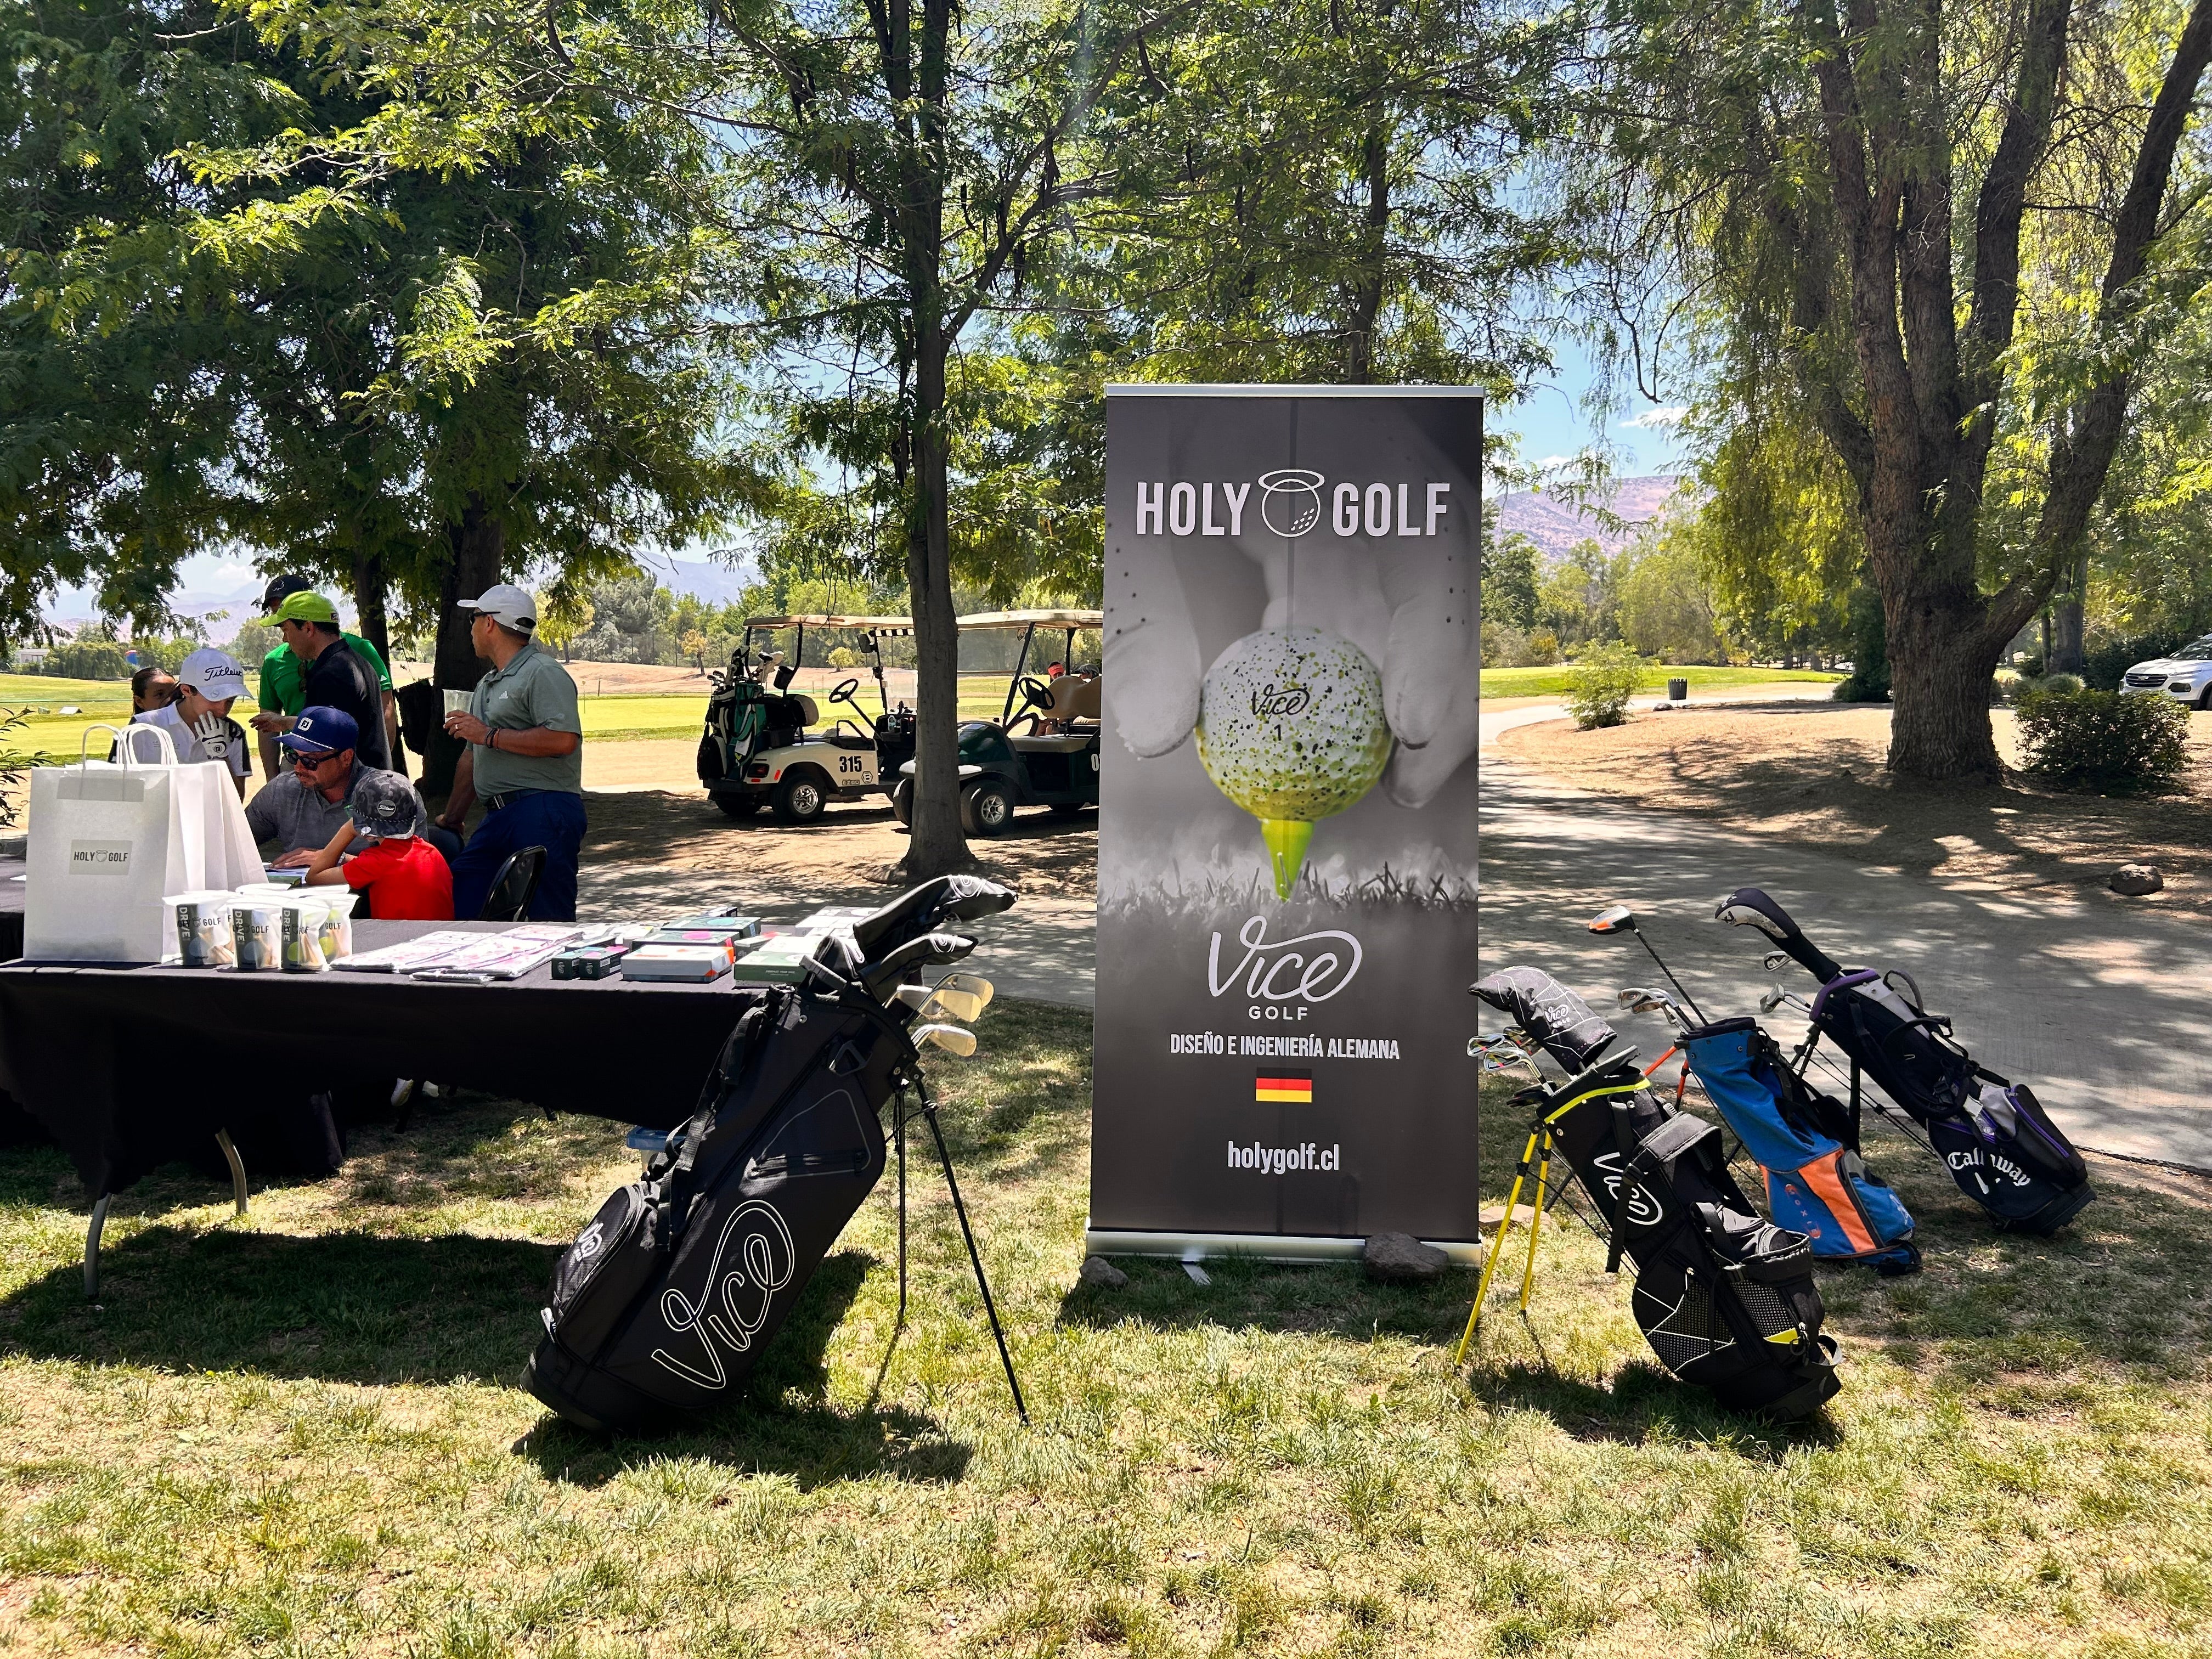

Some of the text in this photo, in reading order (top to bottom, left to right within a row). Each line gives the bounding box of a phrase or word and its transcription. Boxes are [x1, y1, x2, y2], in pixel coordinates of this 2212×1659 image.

[1136, 482, 1450, 537] HOLY GOLF
[204, 665, 242, 681] Titleist
[1251, 684, 1310, 715] Vice
[1274, 724, 1282, 741] 1
[839, 756, 862, 772] 315
[1091, 754, 1100, 771] 0
[74, 851, 128, 861] HOLY GOLF
[203, 917, 222, 926] GOLF
[1207, 915, 1362, 1001] Vice
[1248, 1005, 1308, 1020] GOLF
[1544, 1004, 1569, 1022] Vice
[1170, 1031, 1400, 1059] DISEÑO E INGENIERÍA ALEMANA
[1228, 1141, 1340, 1175] holygolf.cl
[1948, 1147, 2031, 1186] Callway
[652, 1200, 795, 1390] Vice
